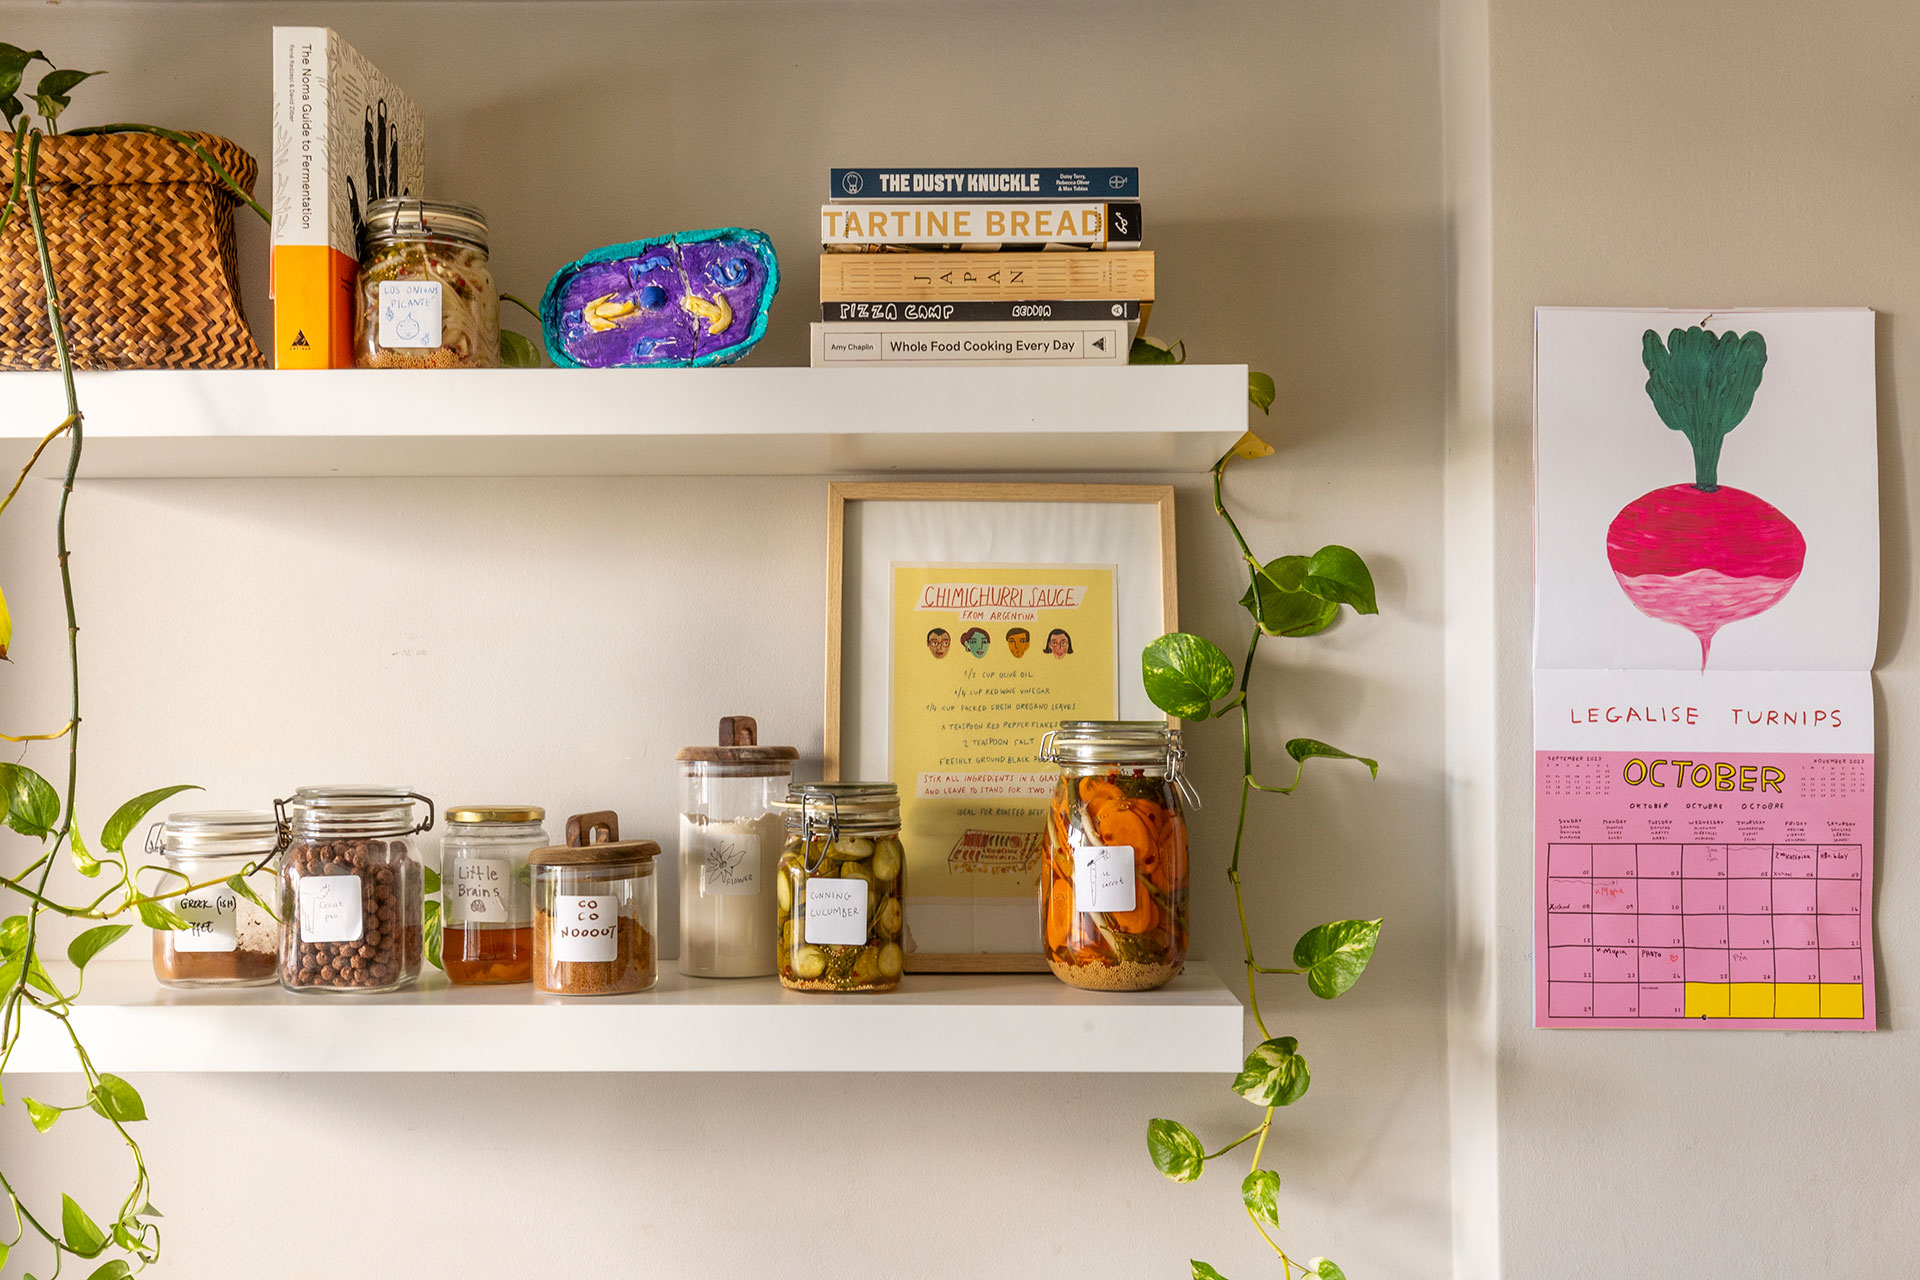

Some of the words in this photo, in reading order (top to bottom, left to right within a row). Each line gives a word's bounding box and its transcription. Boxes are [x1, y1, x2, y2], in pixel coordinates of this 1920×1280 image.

[302, 44, 312, 65] The
[302, 68, 312, 101] Noma
[302, 104, 313, 137] Guide
[302, 140, 311, 152] to
[879, 173, 910, 192] THE
[913, 173, 965, 192] DUSTY
[967, 173, 1040, 192] KNUCKLE
[302, 155, 312, 229] Fermentation
[823, 210, 971, 237] TARTINE
[986, 210, 1102, 237] BREAD
[914, 270, 1024, 285] JAPAN
[384, 286, 400, 295] LOS
[840, 303, 898, 320] PIZZA
[904, 304, 954, 320] CAMP
[831, 343, 847, 352] Amy
[848, 343, 874, 352] Chaplin
[890, 341, 928, 352] Whole
[931, 341, 960, 352] Food
[964, 340, 1012, 353] Cooking
[1016, 340, 1050, 353] Every
[1053, 340, 1075, 352] Day
[924, 586, 1023, 606] CHIMICHURRI
[1028, 586, 1075, 606] SAUCE
[962, 610, 984, 619] FROM
[982, 671, 995, 679] CUP
[999, 671, 1017, 679] OLIVE
[970, 688, 982, 696] CUP
[1020, 687, 1050, 695] VINEGAR
[960, 704, 987, 712] PACKED
[1016, 703, 1048, 711] OREGANO
[1051, 703, 1076, 711] LEAVES
[1570, 706, 1699, 724] LEGALISE
[1731, 708, 1842, 728] TURNIPS
[949, 722, 983, 730] TEASPOON
[1003, 721, 1030, 729] PEPPER
[1031, 721, 1058, 729] FLAKES
[972, 738, 1009, 746] TEASPOON
[1014, 738, 1035, 746] SALT
[939, 757, 972, 766] FRESHLY
[1007, 756, 1030, 764] BLACK
[924, 774, 941, 783] STIR
[1030, 774, 1035, 782] A
[1622, 757, 1786, 793] OCTOBER
[943, 786, 966, 794] LEAVE
[1008, 786, 1021, 794] FOR
[1027, 786, 1045, 794] TWO
[957, 808, 975, 816] IDEAL
[996, 808, 1024, 816] ROASTED
[1028, 808, 1044, 816] BEEF
[458, 865, 499, 881] Little
[726, 875, 753, 886] FLOWER
[1102, 878, 1125, 888] carrot
[458, 883, 500, 898] Brains
[810, 891, 851, 901] CUNNING
[578, 900, 598, 909] CO
[578, 912, 599, 921] CO
[810, 906, 860, 919] CUCUMBER
[561, 925, 617, 939] NOOOUT
